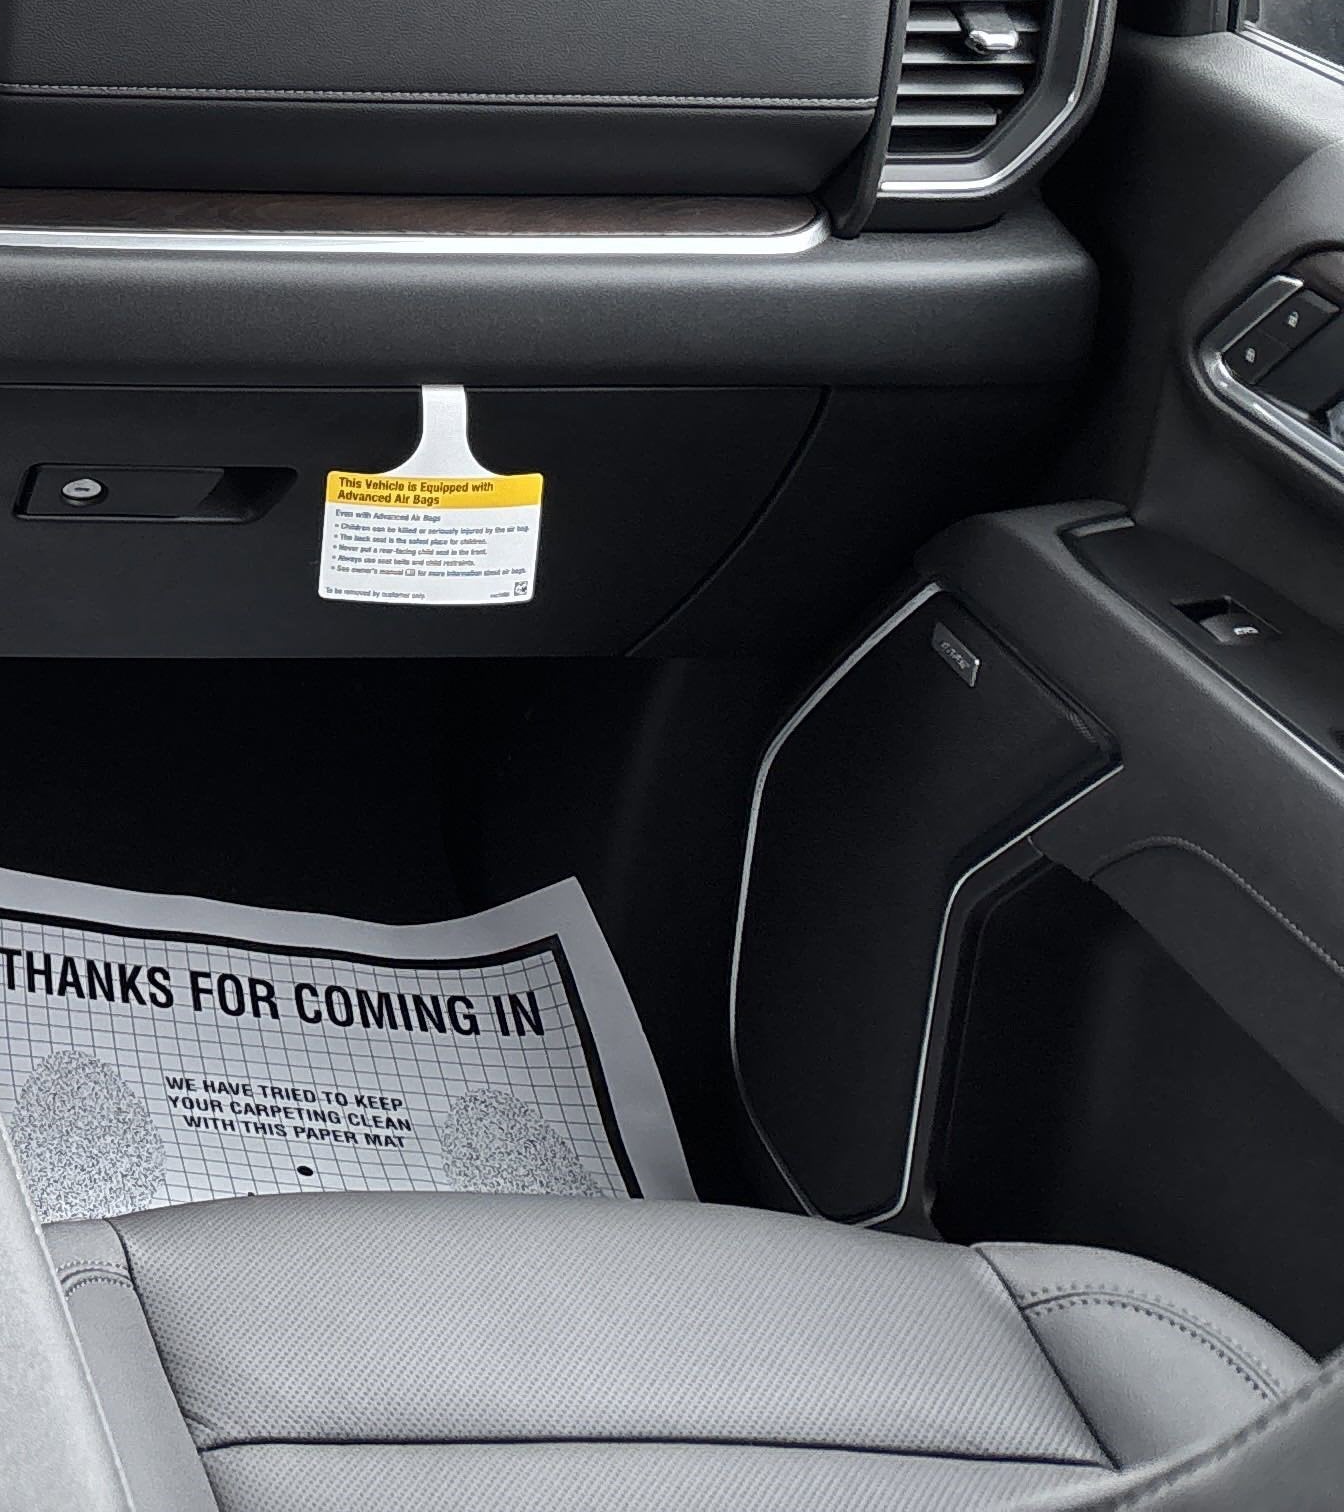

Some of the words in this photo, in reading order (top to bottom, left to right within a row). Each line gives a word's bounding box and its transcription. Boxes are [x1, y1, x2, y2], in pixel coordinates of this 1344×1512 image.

[339, 477, 361, 490] This
[366, 480, 405, 492] Vehicle
[408, 482, 417, 492] is
[420, 482, 469, 495] Equipped
[472, 483, 494, 492] with
[338, 490, 391, 504] Advanced
[394, 493, 410, 505] Air
[413, 495, 440, 507] Bags
[336, 509, 353, 518] Even
[356, 511, 371, 519] with
[373, 512, 409, 521] Advanced
[411, 514, 420, 522] Air
[423, 514, 441, 523] Bags
[341, 523, 371, 532] Children
[398, 526, 417, 534] killed
[428, 527, 459, 536] seriously
[460, 527, 484, 535] injured
[485, 526, 493, 535] by
[340, 533, 352, 541] The
[396, 537, 407, 545] the
[344, 589, 369, 598] removed
[371, 590, 380, 599] by
[382, 591, 410, 599] customer
[190, 970, 280, 1020] FOR
[295, 982, 480, 1036] COMING
[493, 990, 545, 1036] IN
[166, 1076, 197, 1092] WE
[203, 1080, 253, 1097] HAVE
[258, 1084, 316, 1103] TRIED
[322, 1091, 348, 1107] TO
[355, 1095, 403, 1112] KEEP
[168, 1095, 224, 1113] YOUR
[230, 1101, 341, 1125] CARPETING
[347, 1112, 412, 1132] CLEAN
[183, 1115, 235, 1132] WITH
[241, 1120, 287, 1137] THIS
[294, 1125, 358, 1145] PAPER
[365, 1133, 405, 1149] MAT
